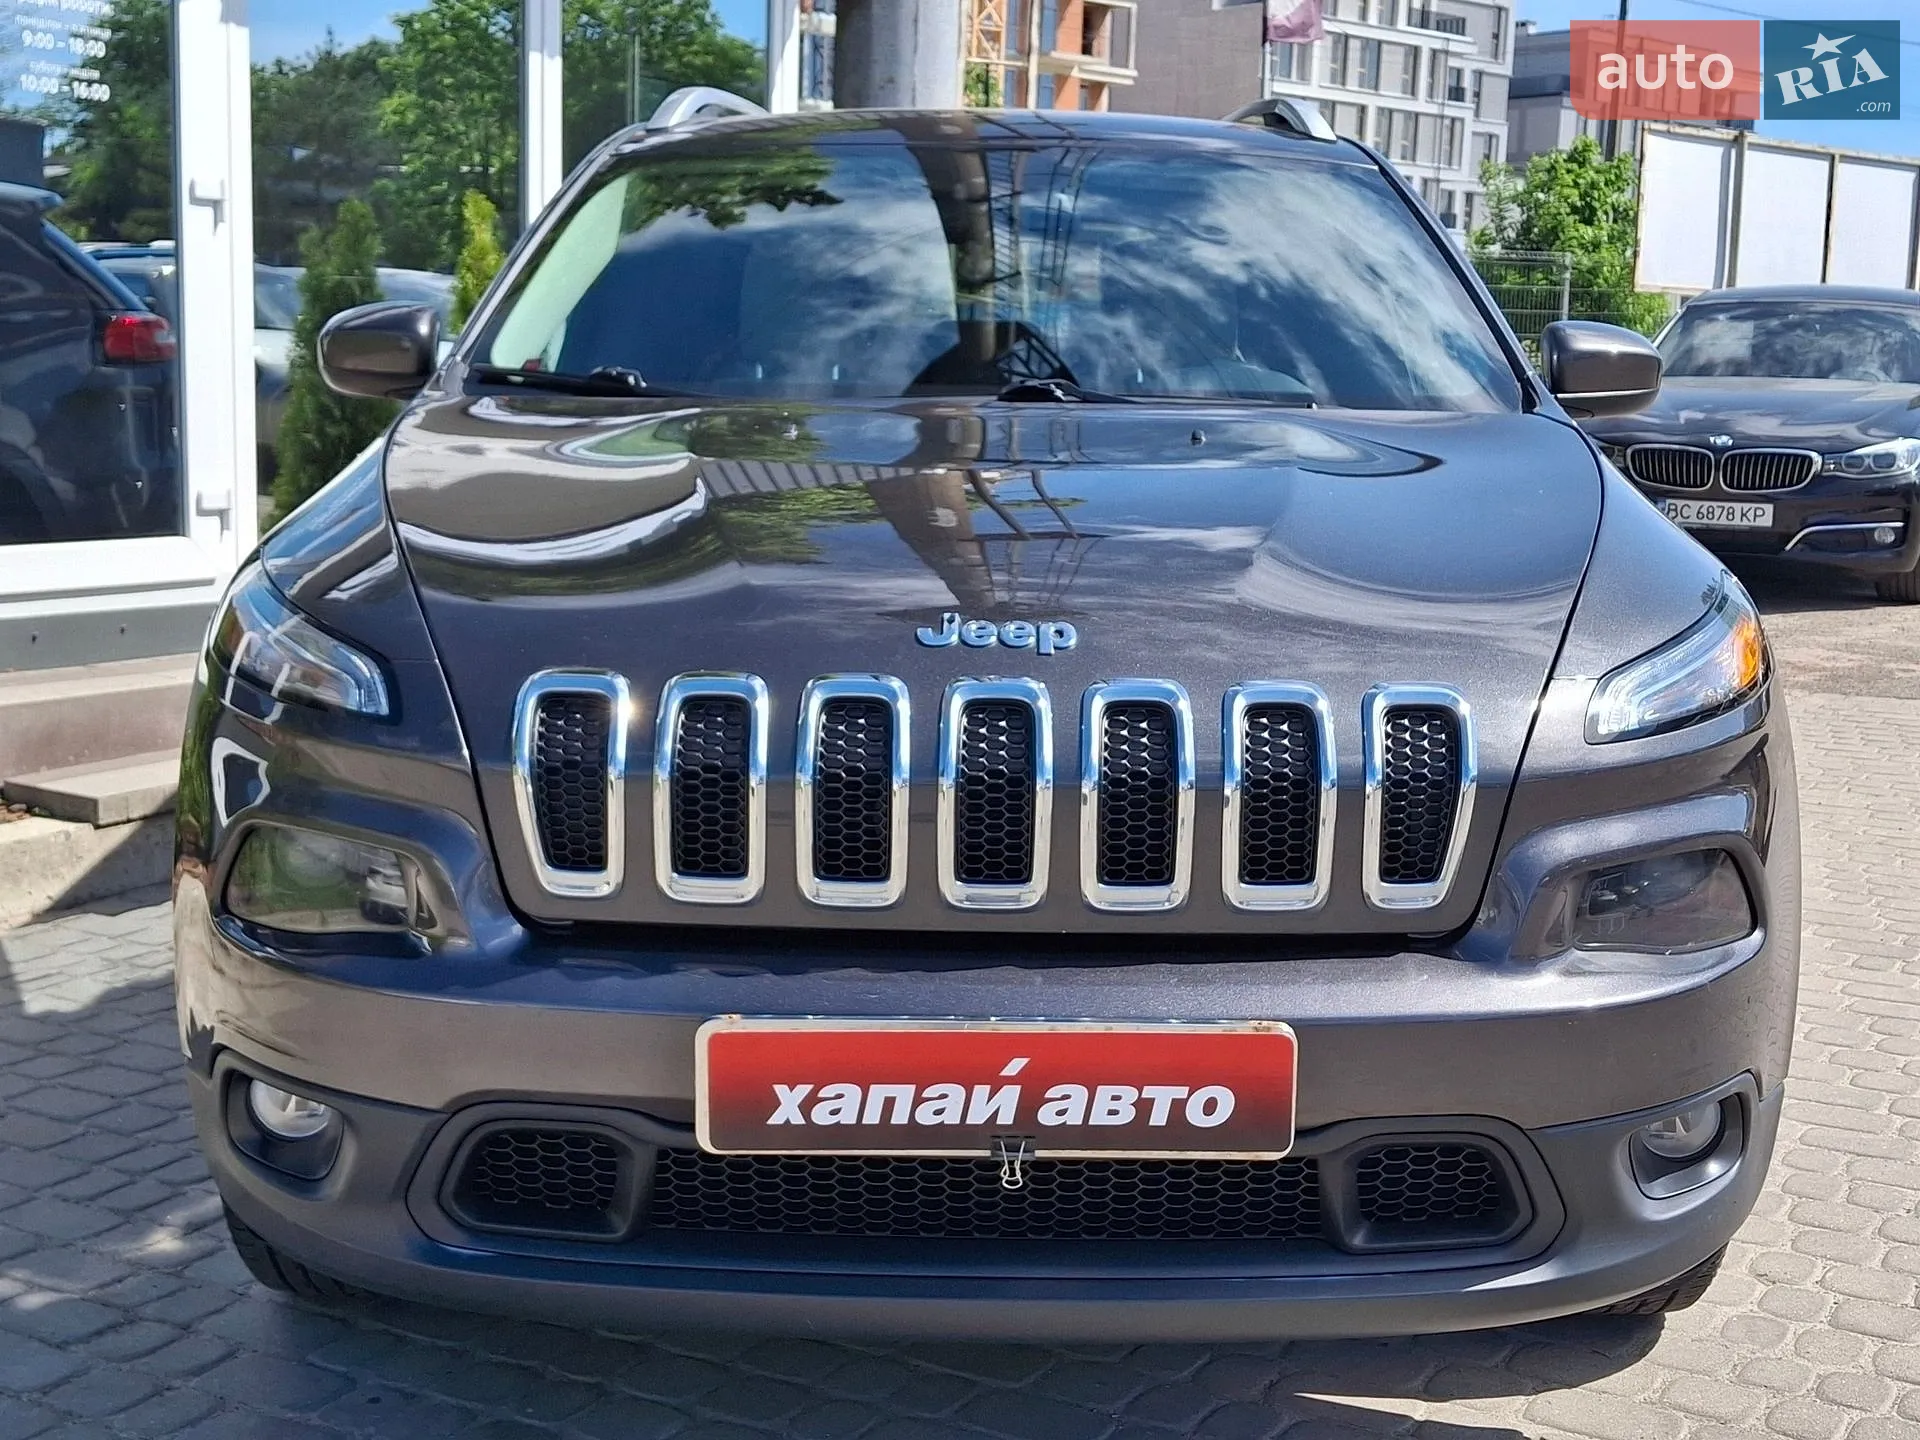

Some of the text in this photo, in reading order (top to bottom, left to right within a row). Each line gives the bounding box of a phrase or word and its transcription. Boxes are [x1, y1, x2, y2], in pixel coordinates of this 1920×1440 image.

[1667, 502, 1766, 524] BC 6878 KP
[916, 612, 1077, 655] Jeep
[766, 1057, 1236, 1128] хапай авто
